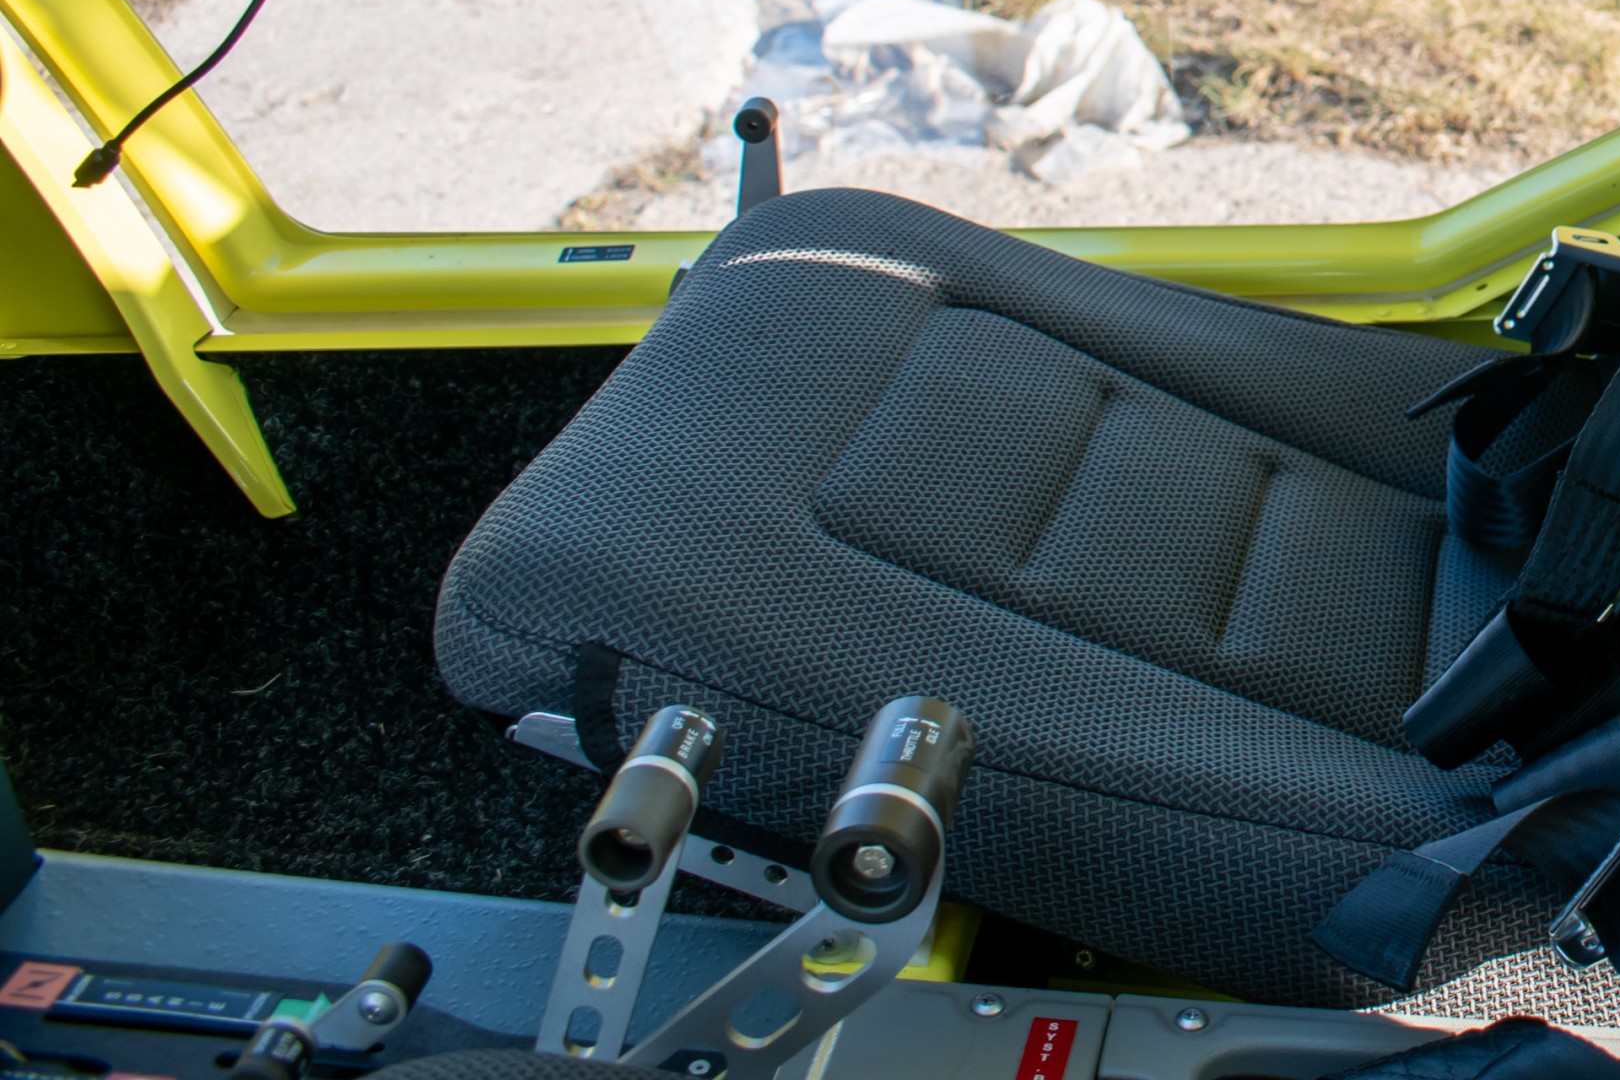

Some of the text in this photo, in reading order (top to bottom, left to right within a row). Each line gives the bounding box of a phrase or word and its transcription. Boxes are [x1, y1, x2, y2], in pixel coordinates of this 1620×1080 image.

[672, 717, 685, 729] OFF
[891, 722, 907, 737] FULL
[677, 728, 698, 759] BRAKE
[900, 729, 921, 761] THROTTLE
